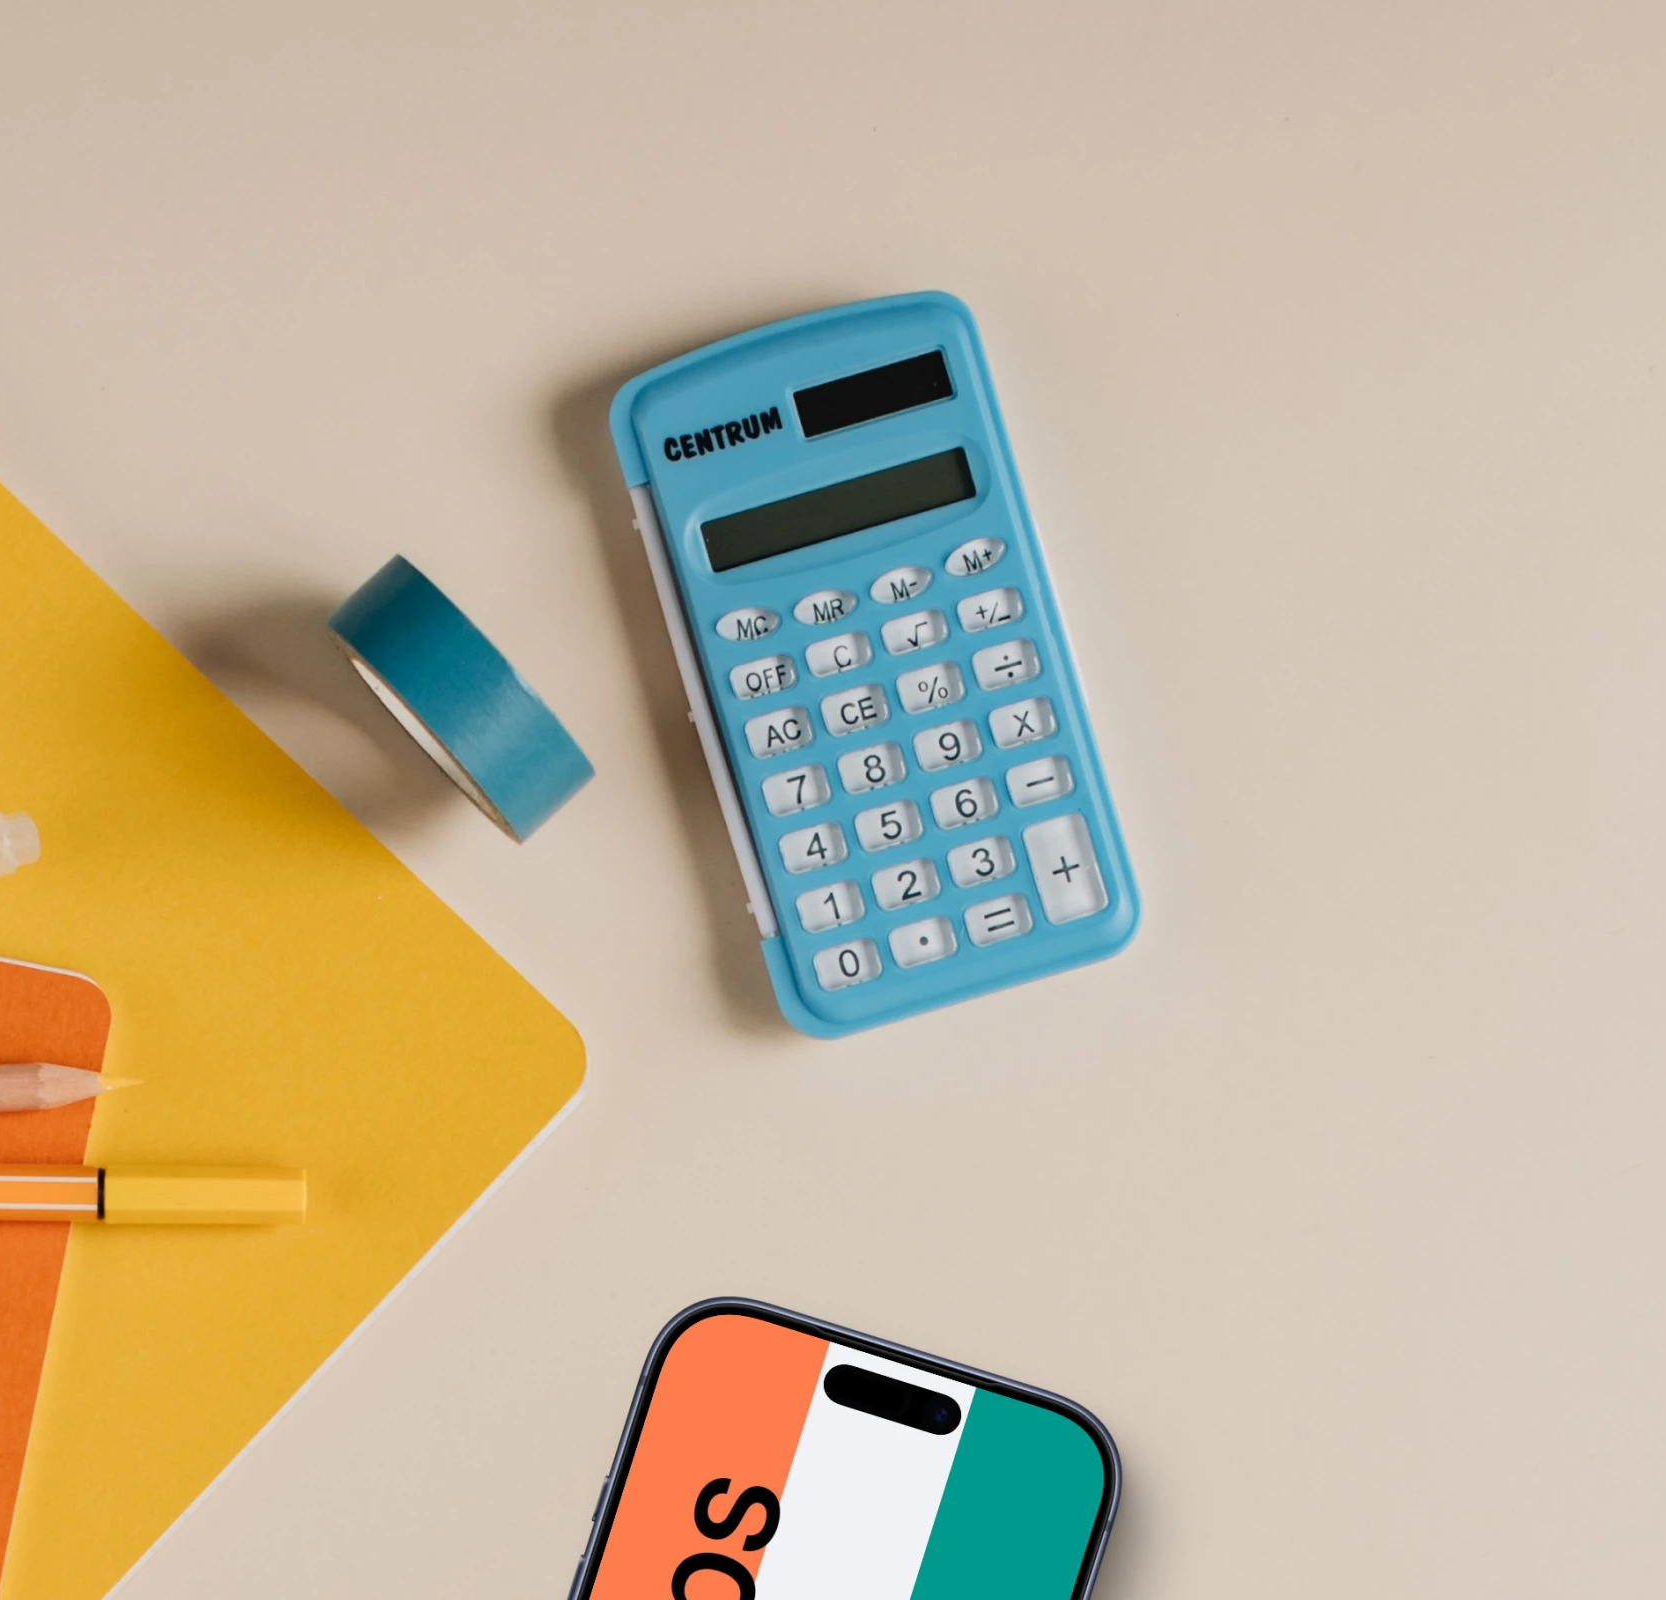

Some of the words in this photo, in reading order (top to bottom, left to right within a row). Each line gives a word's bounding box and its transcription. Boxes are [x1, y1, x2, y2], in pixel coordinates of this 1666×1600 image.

[663, 406, 783, 462] CENTRUM
[736, 615, 769, 641] MC
[812, 598, 845, 625] MR
[745, 664, 788, 694] OFF
[833, 645, 852, 671] C
[767, 718, 802, 748] AC
[840, 696, 878, 726] CE
[786, 774, 807, 806] 7
[863, 754, 886, 784] 8
[938, 732, 962, 761] 9
[806, 832, 828, 860] 4
[880, 810, 903, 840] 5
[954, 789, 978, 818] 6
[823, 892, 841, 921] 1
[896, 870, 922, 901] 2
[971, 848, 995, 877] 3
[838, 949, 860, 978] 0
